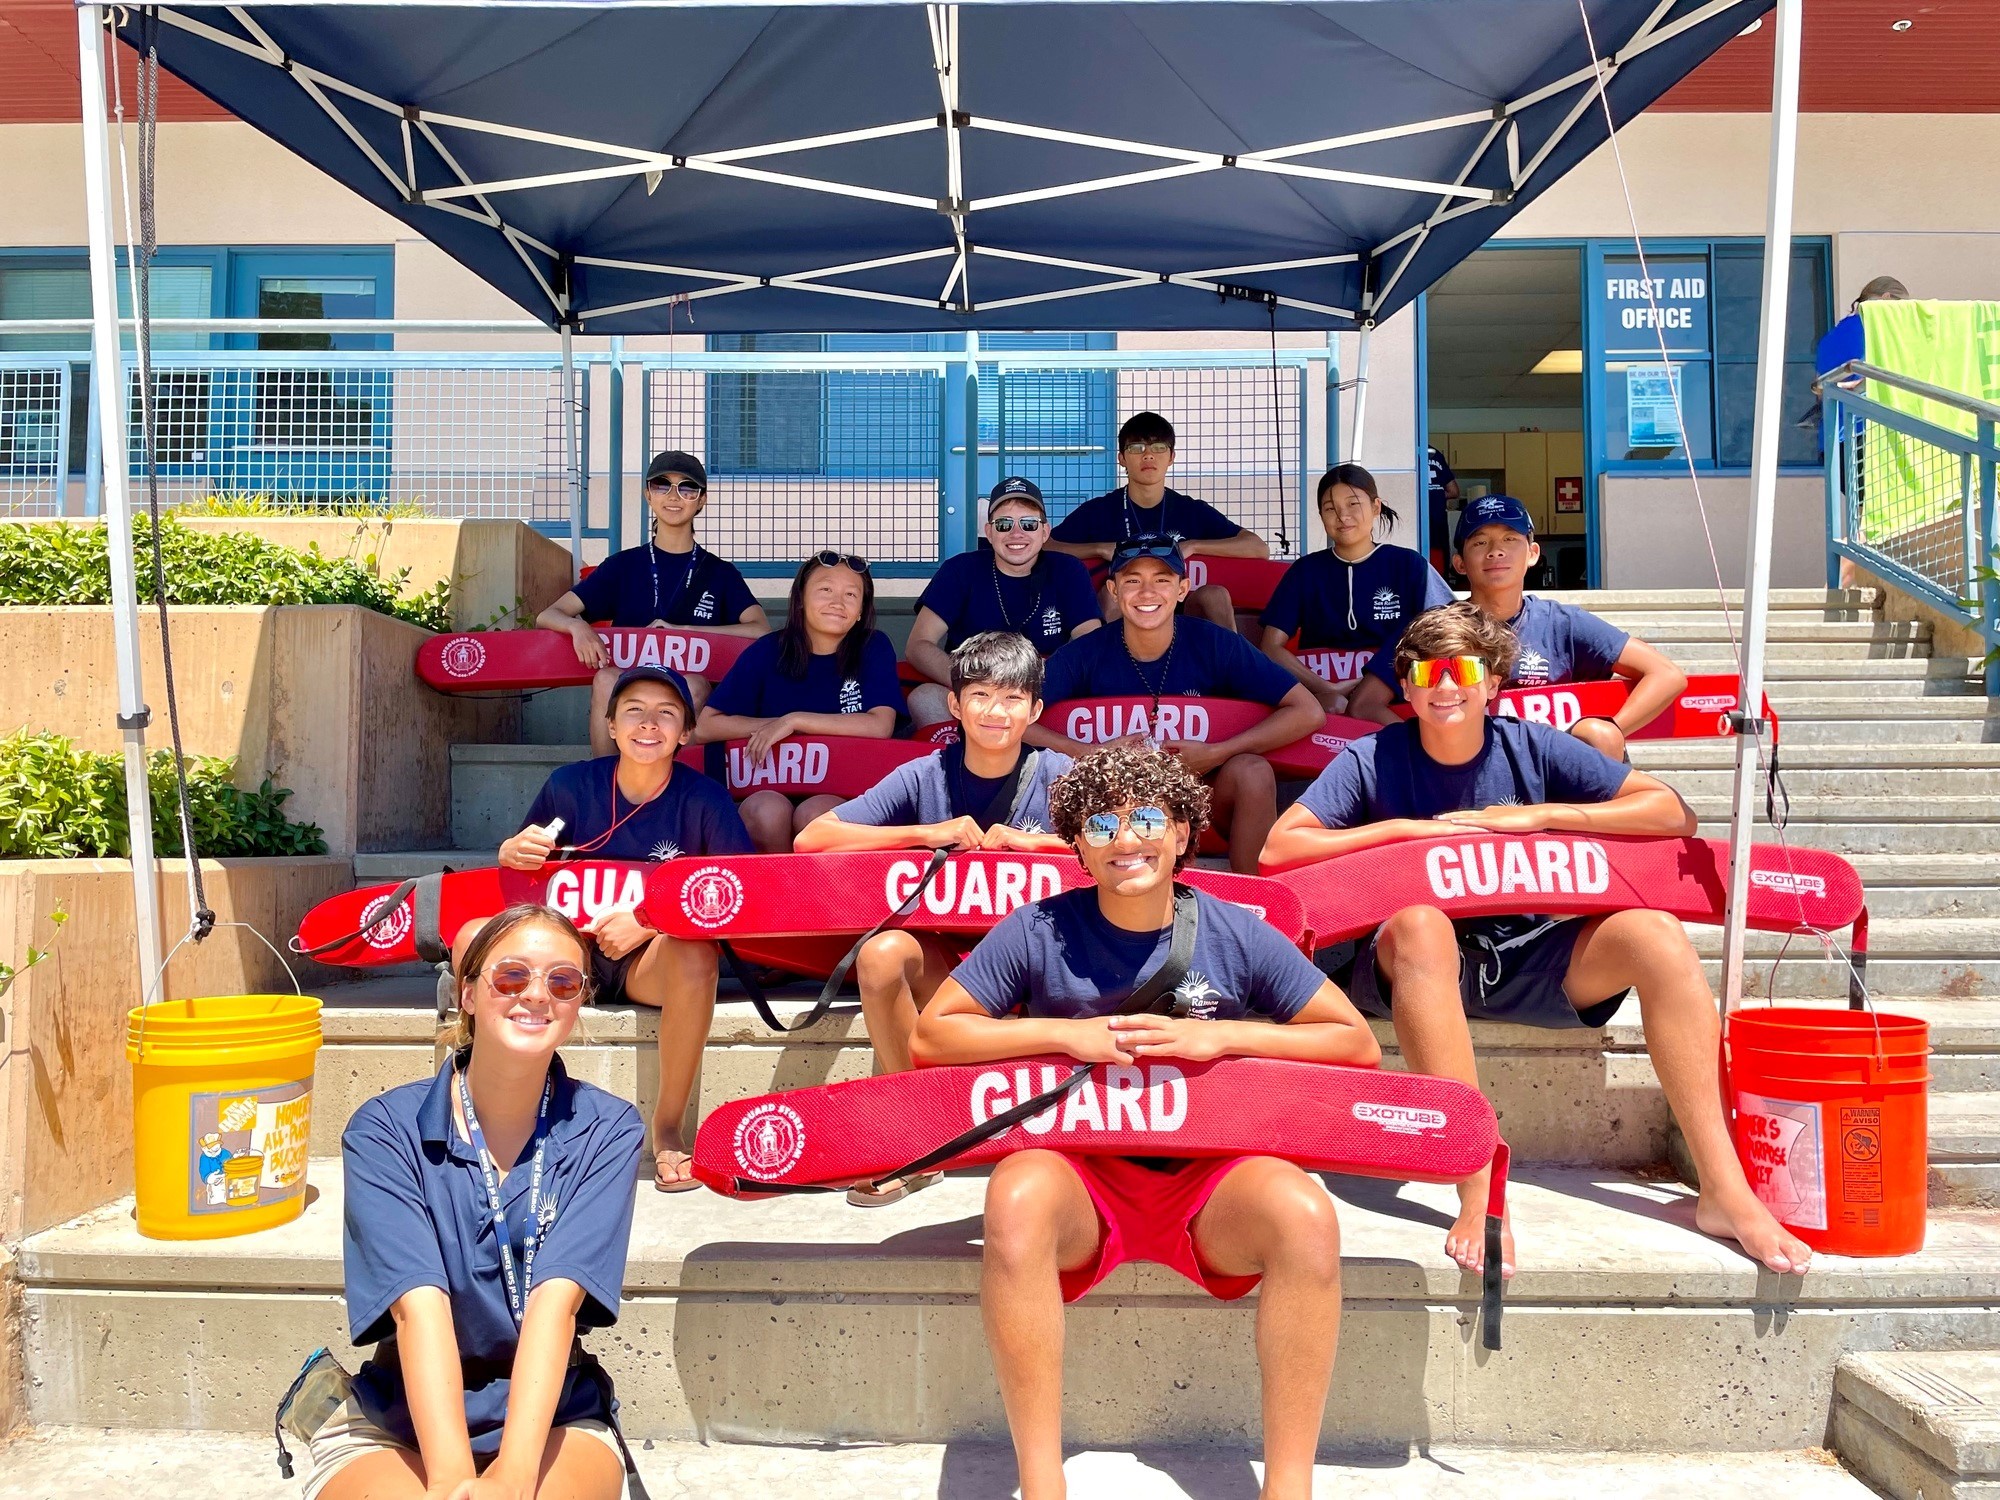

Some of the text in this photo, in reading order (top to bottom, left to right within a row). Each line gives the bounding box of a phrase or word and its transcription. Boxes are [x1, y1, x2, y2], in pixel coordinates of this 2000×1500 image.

[1606, 278, 1705, 299] FIRST AID
[1621, 307, 1692, 329] OFFICE
[694, 609, 712, 619] TAFF
[1374, 612, 1400, 620] STAFF
[1497, 692, 1582, 732] ARD
[1684, 697, 1733, 706] EXOTUBE
[1067, 704, 1209, 744] GUARD
[680, 866, 720, 898] LIFEGUARD
[1425, 840, 1610, 899] GUARD
[1754, 873, 1822, 888] EXOTUBE
[546, 868, 645, 929] GUA
[886, 860, 1062, 915] GUARD
[680, 901, 692, 918] THE
[218, 1097, 257, 1132] HOME
[970, 1064, 1189, 1139] GUARD
[1357, 1106, 1442, 1124] EXOTUBE
[733, 1103, 806, 1159] LIFEGUARD STORE.COM
[734, 1149, 750, 1169] THE
[480, 1149, 499, 1210] City of San Ramon
[531, 1151, 543, 1214] City of San Ramon
[525, 1250, 534, 1264] City
[502, 1244, 520, 1309] City of San Ramon
